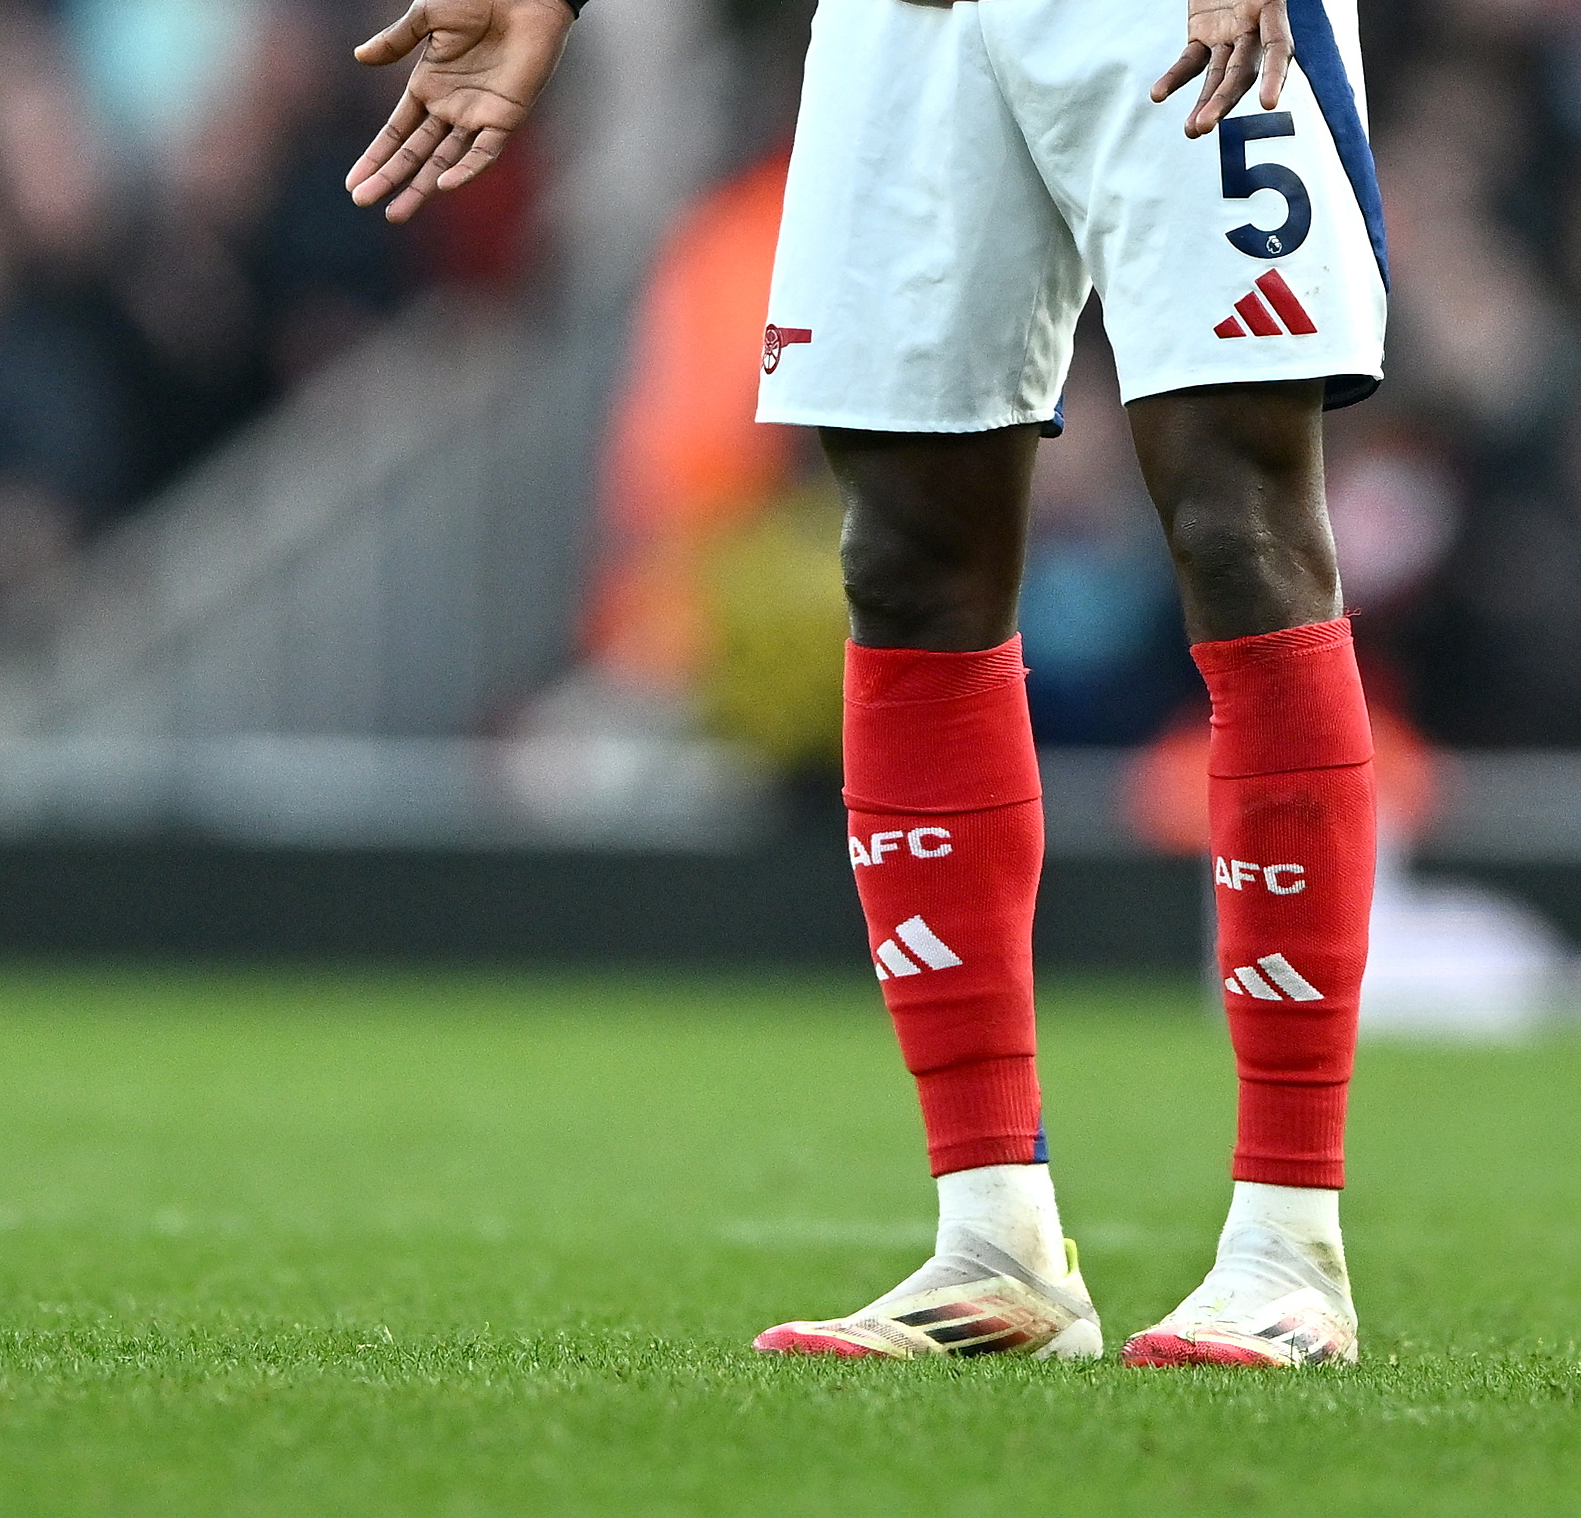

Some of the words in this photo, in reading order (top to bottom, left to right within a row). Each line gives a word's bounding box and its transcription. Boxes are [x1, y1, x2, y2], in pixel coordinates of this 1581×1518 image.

[1219, 111, 1312, 259] 5
[849, 827, 953, 871] AFC
[1215, 856, 1306, 895] AFC
